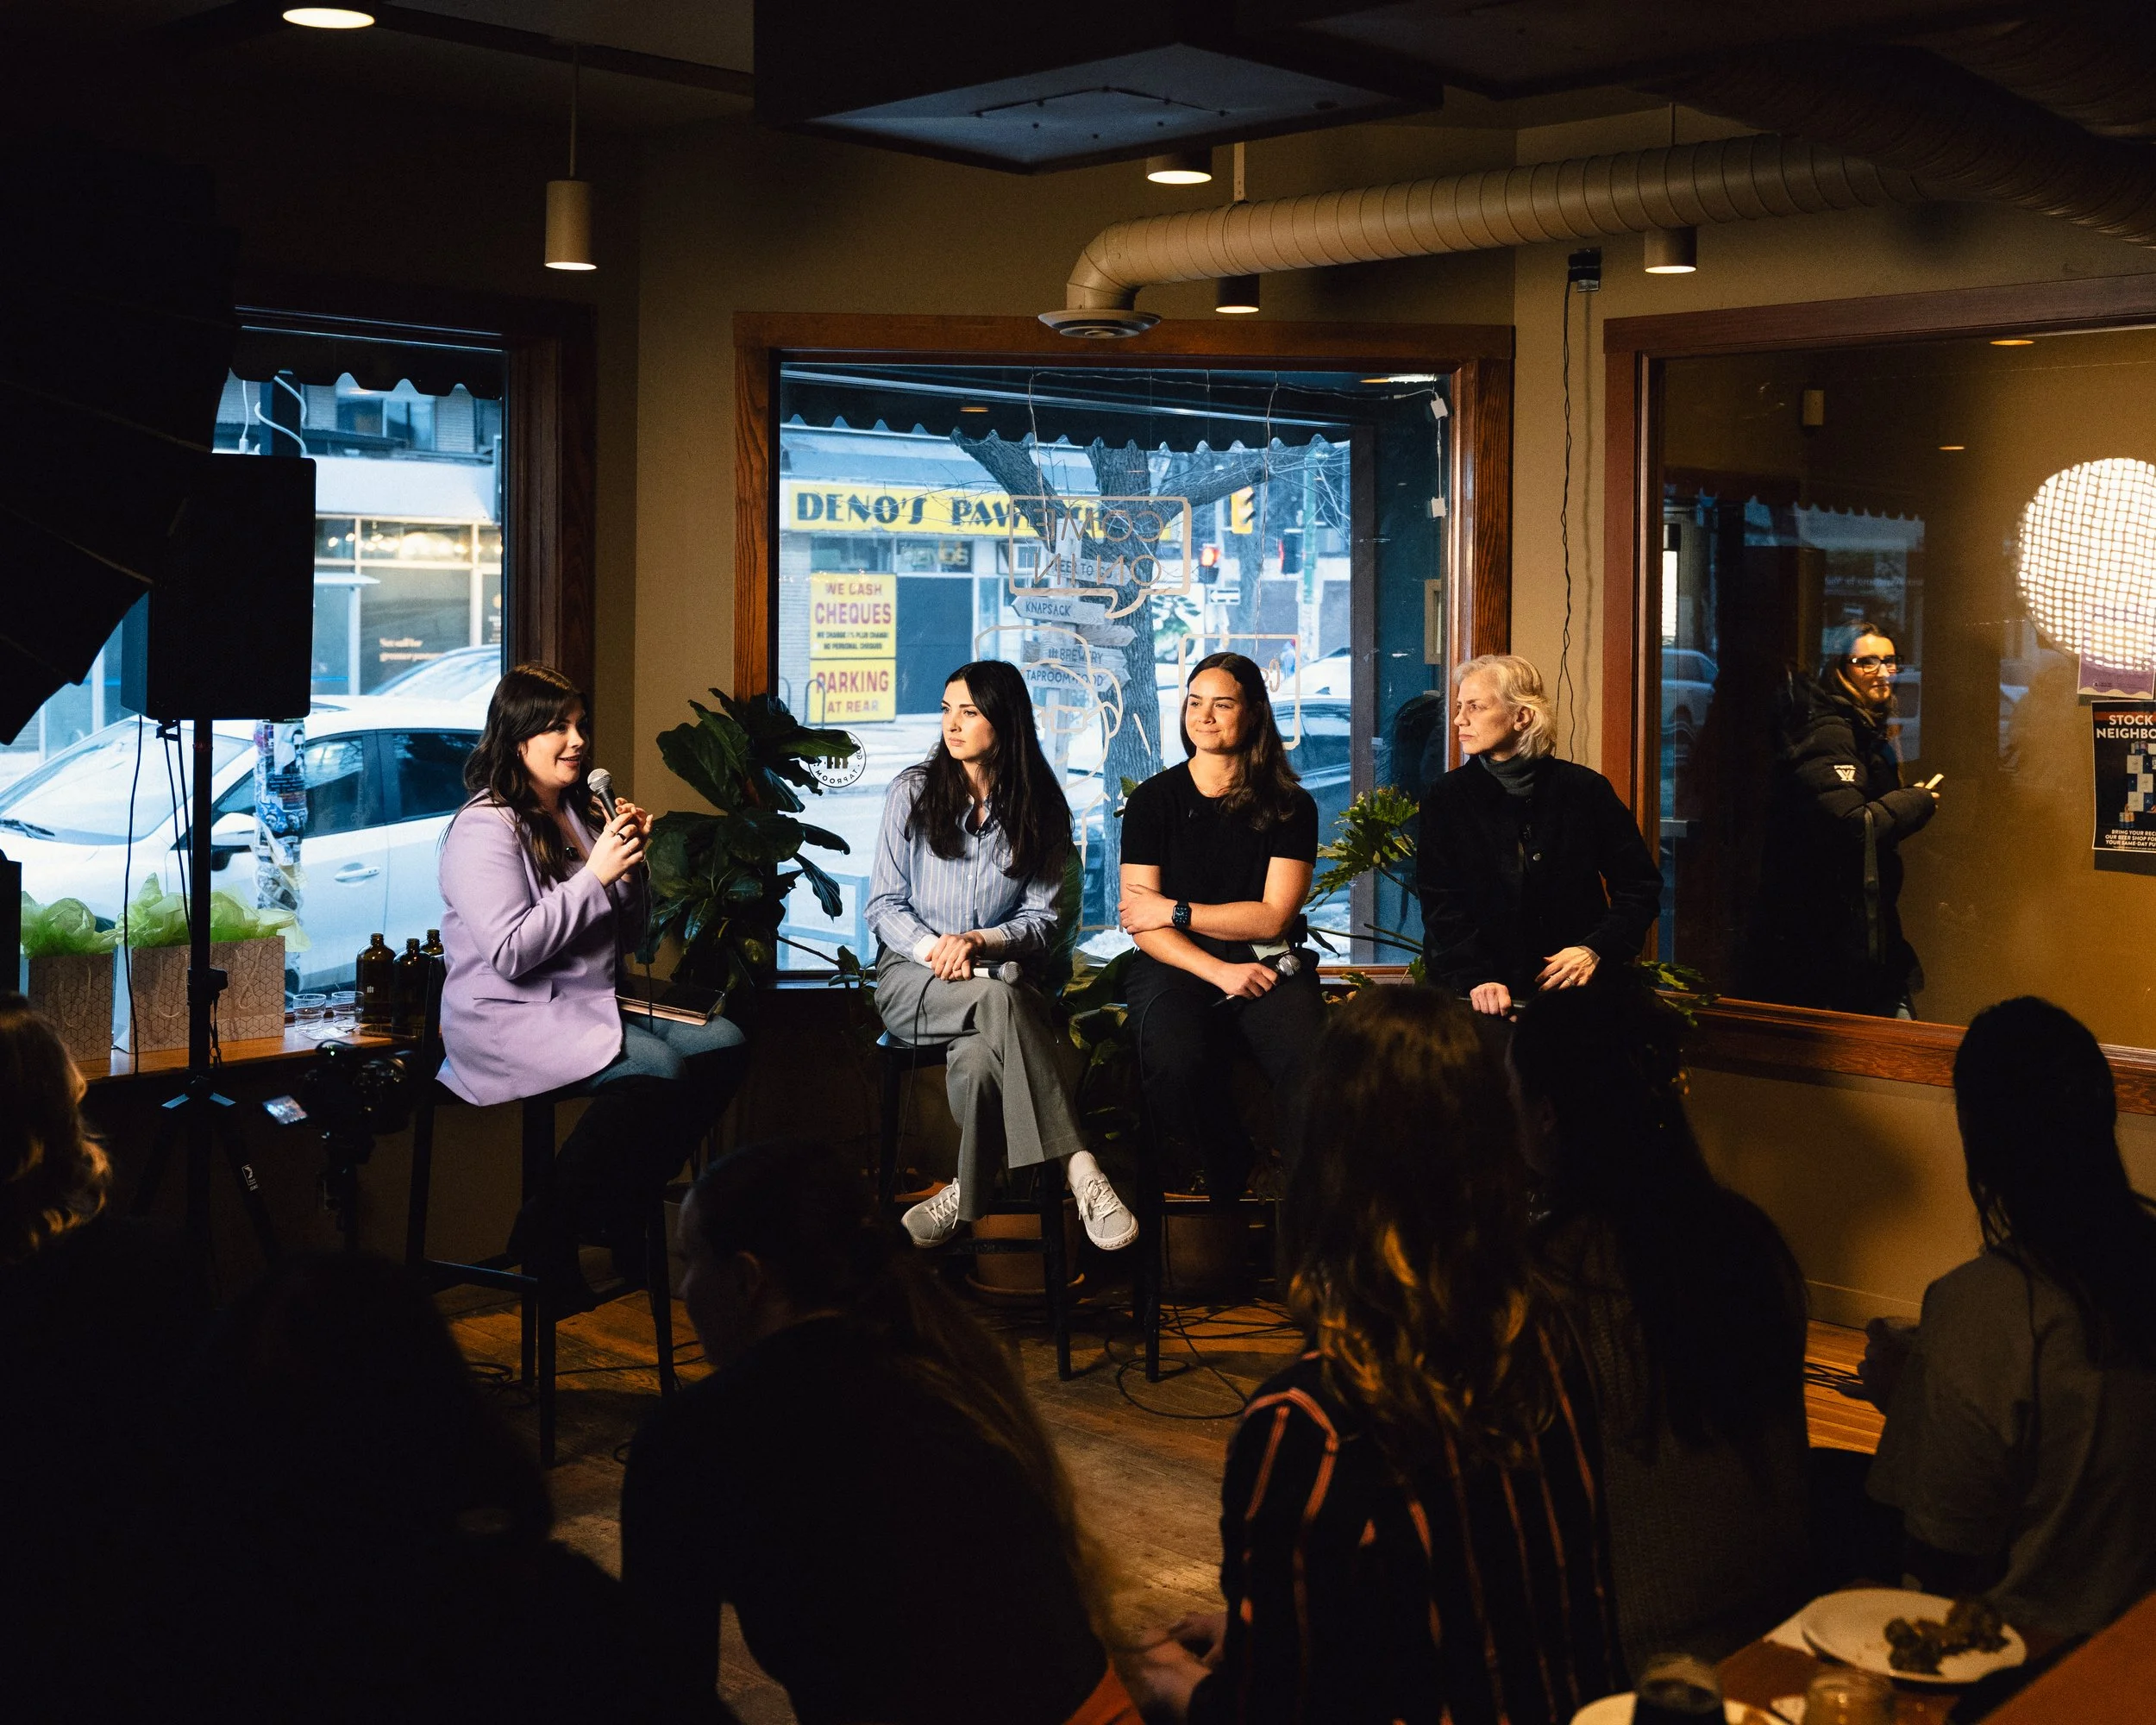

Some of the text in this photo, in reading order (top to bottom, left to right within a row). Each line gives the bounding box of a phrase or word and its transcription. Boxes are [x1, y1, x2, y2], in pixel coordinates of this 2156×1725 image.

[797, 492, 927, 524] DENO'S
[1081, 563, 1094, 576] TO
[825, 583, 882, 596] WE CASH
[815, 602, 892, 624] CHEQUES
[1025, 601, 1071, 617] KNAPSACK
[816, 670, 889, 693] PARKING
[1026, 669, 1070, 684] TAPROOM
[828, 699, 879, 713] AT REAR
[2109, 714, 2153, 725] STOCK
